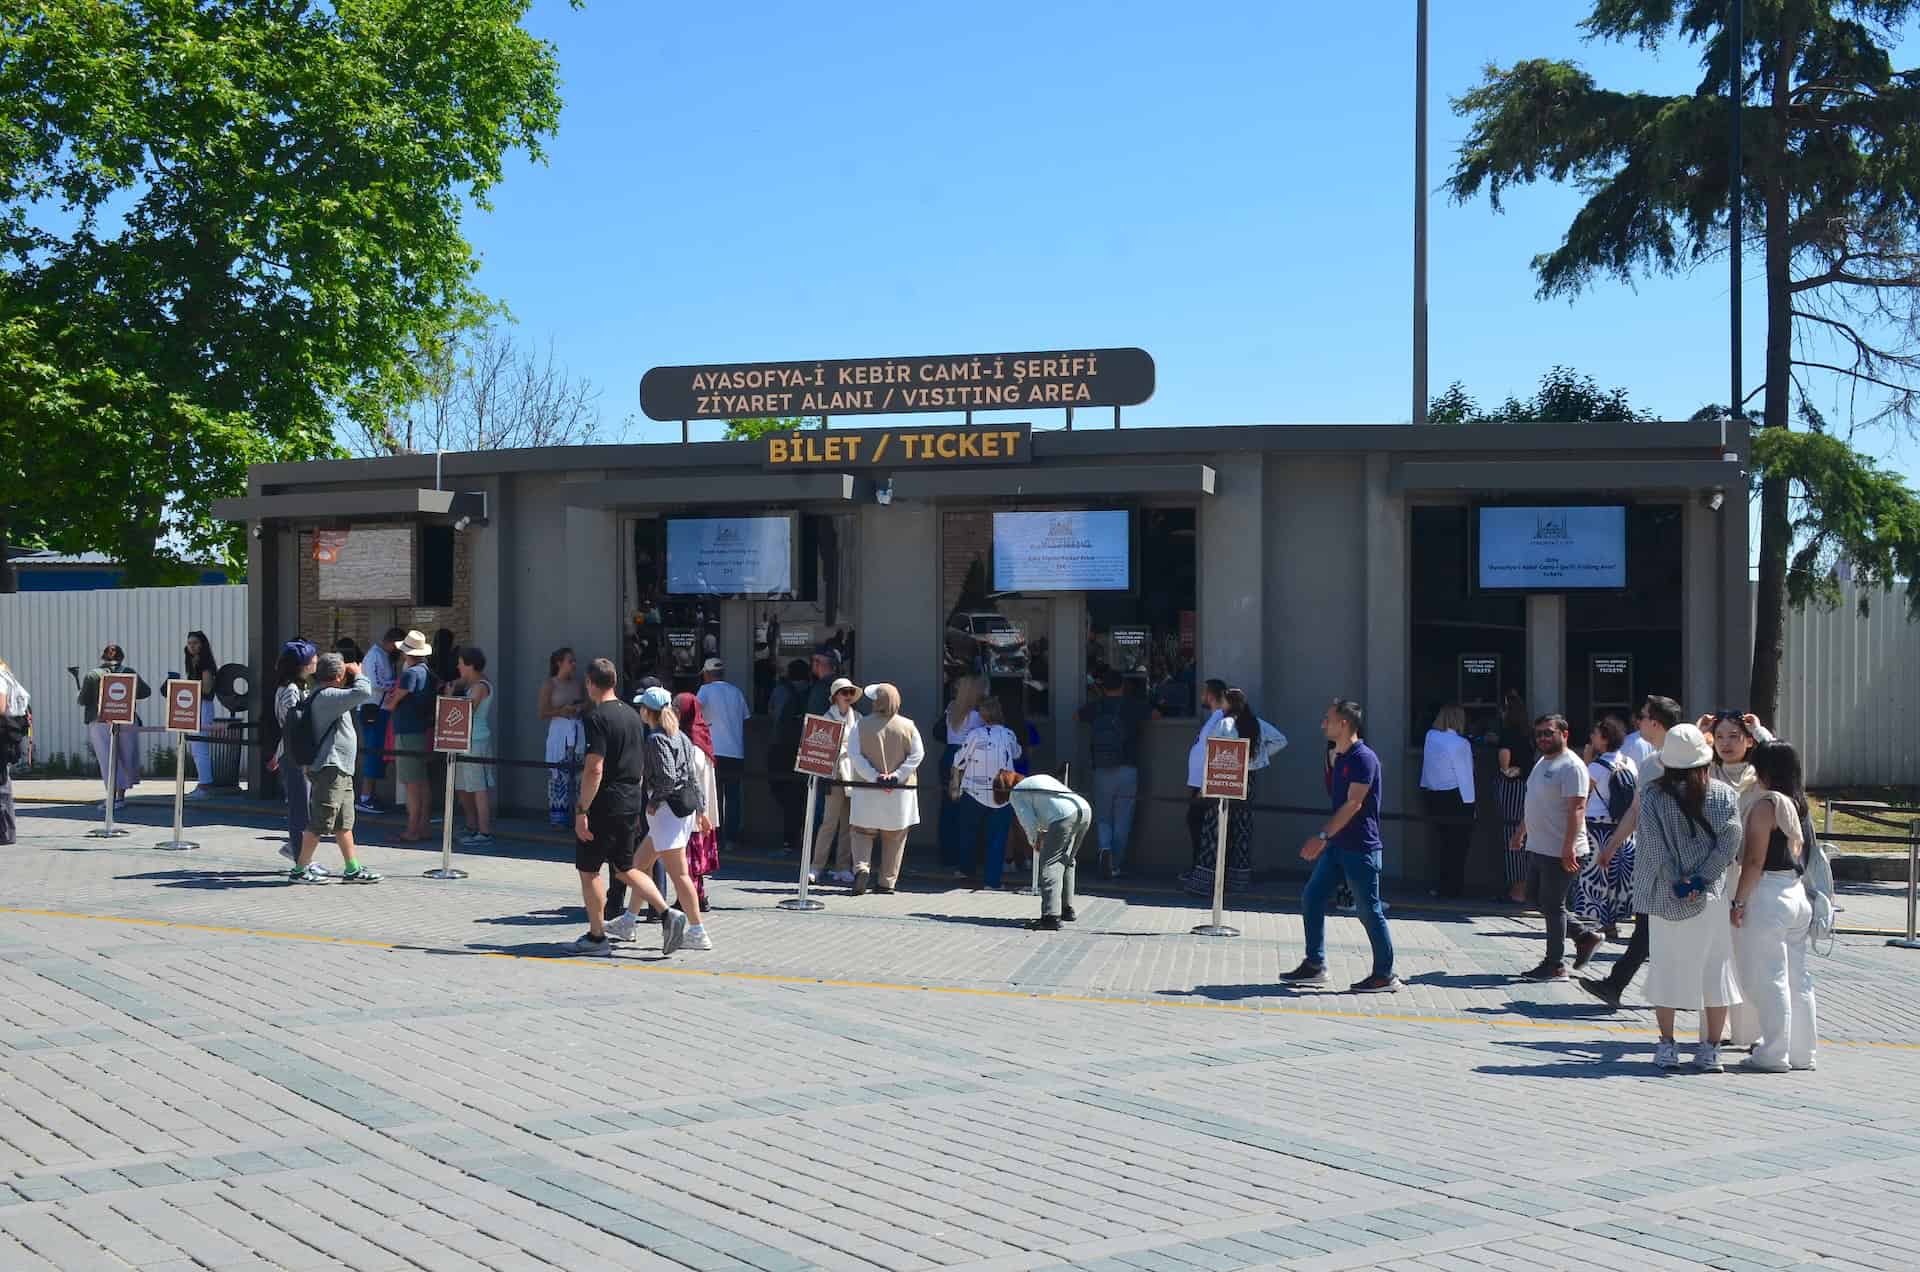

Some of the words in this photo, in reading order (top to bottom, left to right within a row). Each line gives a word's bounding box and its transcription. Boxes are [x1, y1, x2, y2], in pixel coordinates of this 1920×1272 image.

[692, 363, 824, 390] AYASOFYA-İ
[839, 361, 911, 385] KEBİR
[919, 357, 1004, 382] CAMİ-İ
[1013, 353, 1097, 384] ŞERİFİ
[696, 391, 793, 414] ZİYARET
[801, 390, 874, 410] ALANI
[882, 388, 895, 409] /
[902, 384, 1021, 407] VISITING
[1028, 383, 1091, 402] AREA
[769, 430, 862, 464] BİLET
[871, 433, 891, 463] /
[899, 431, 1021, 459] TICKET
